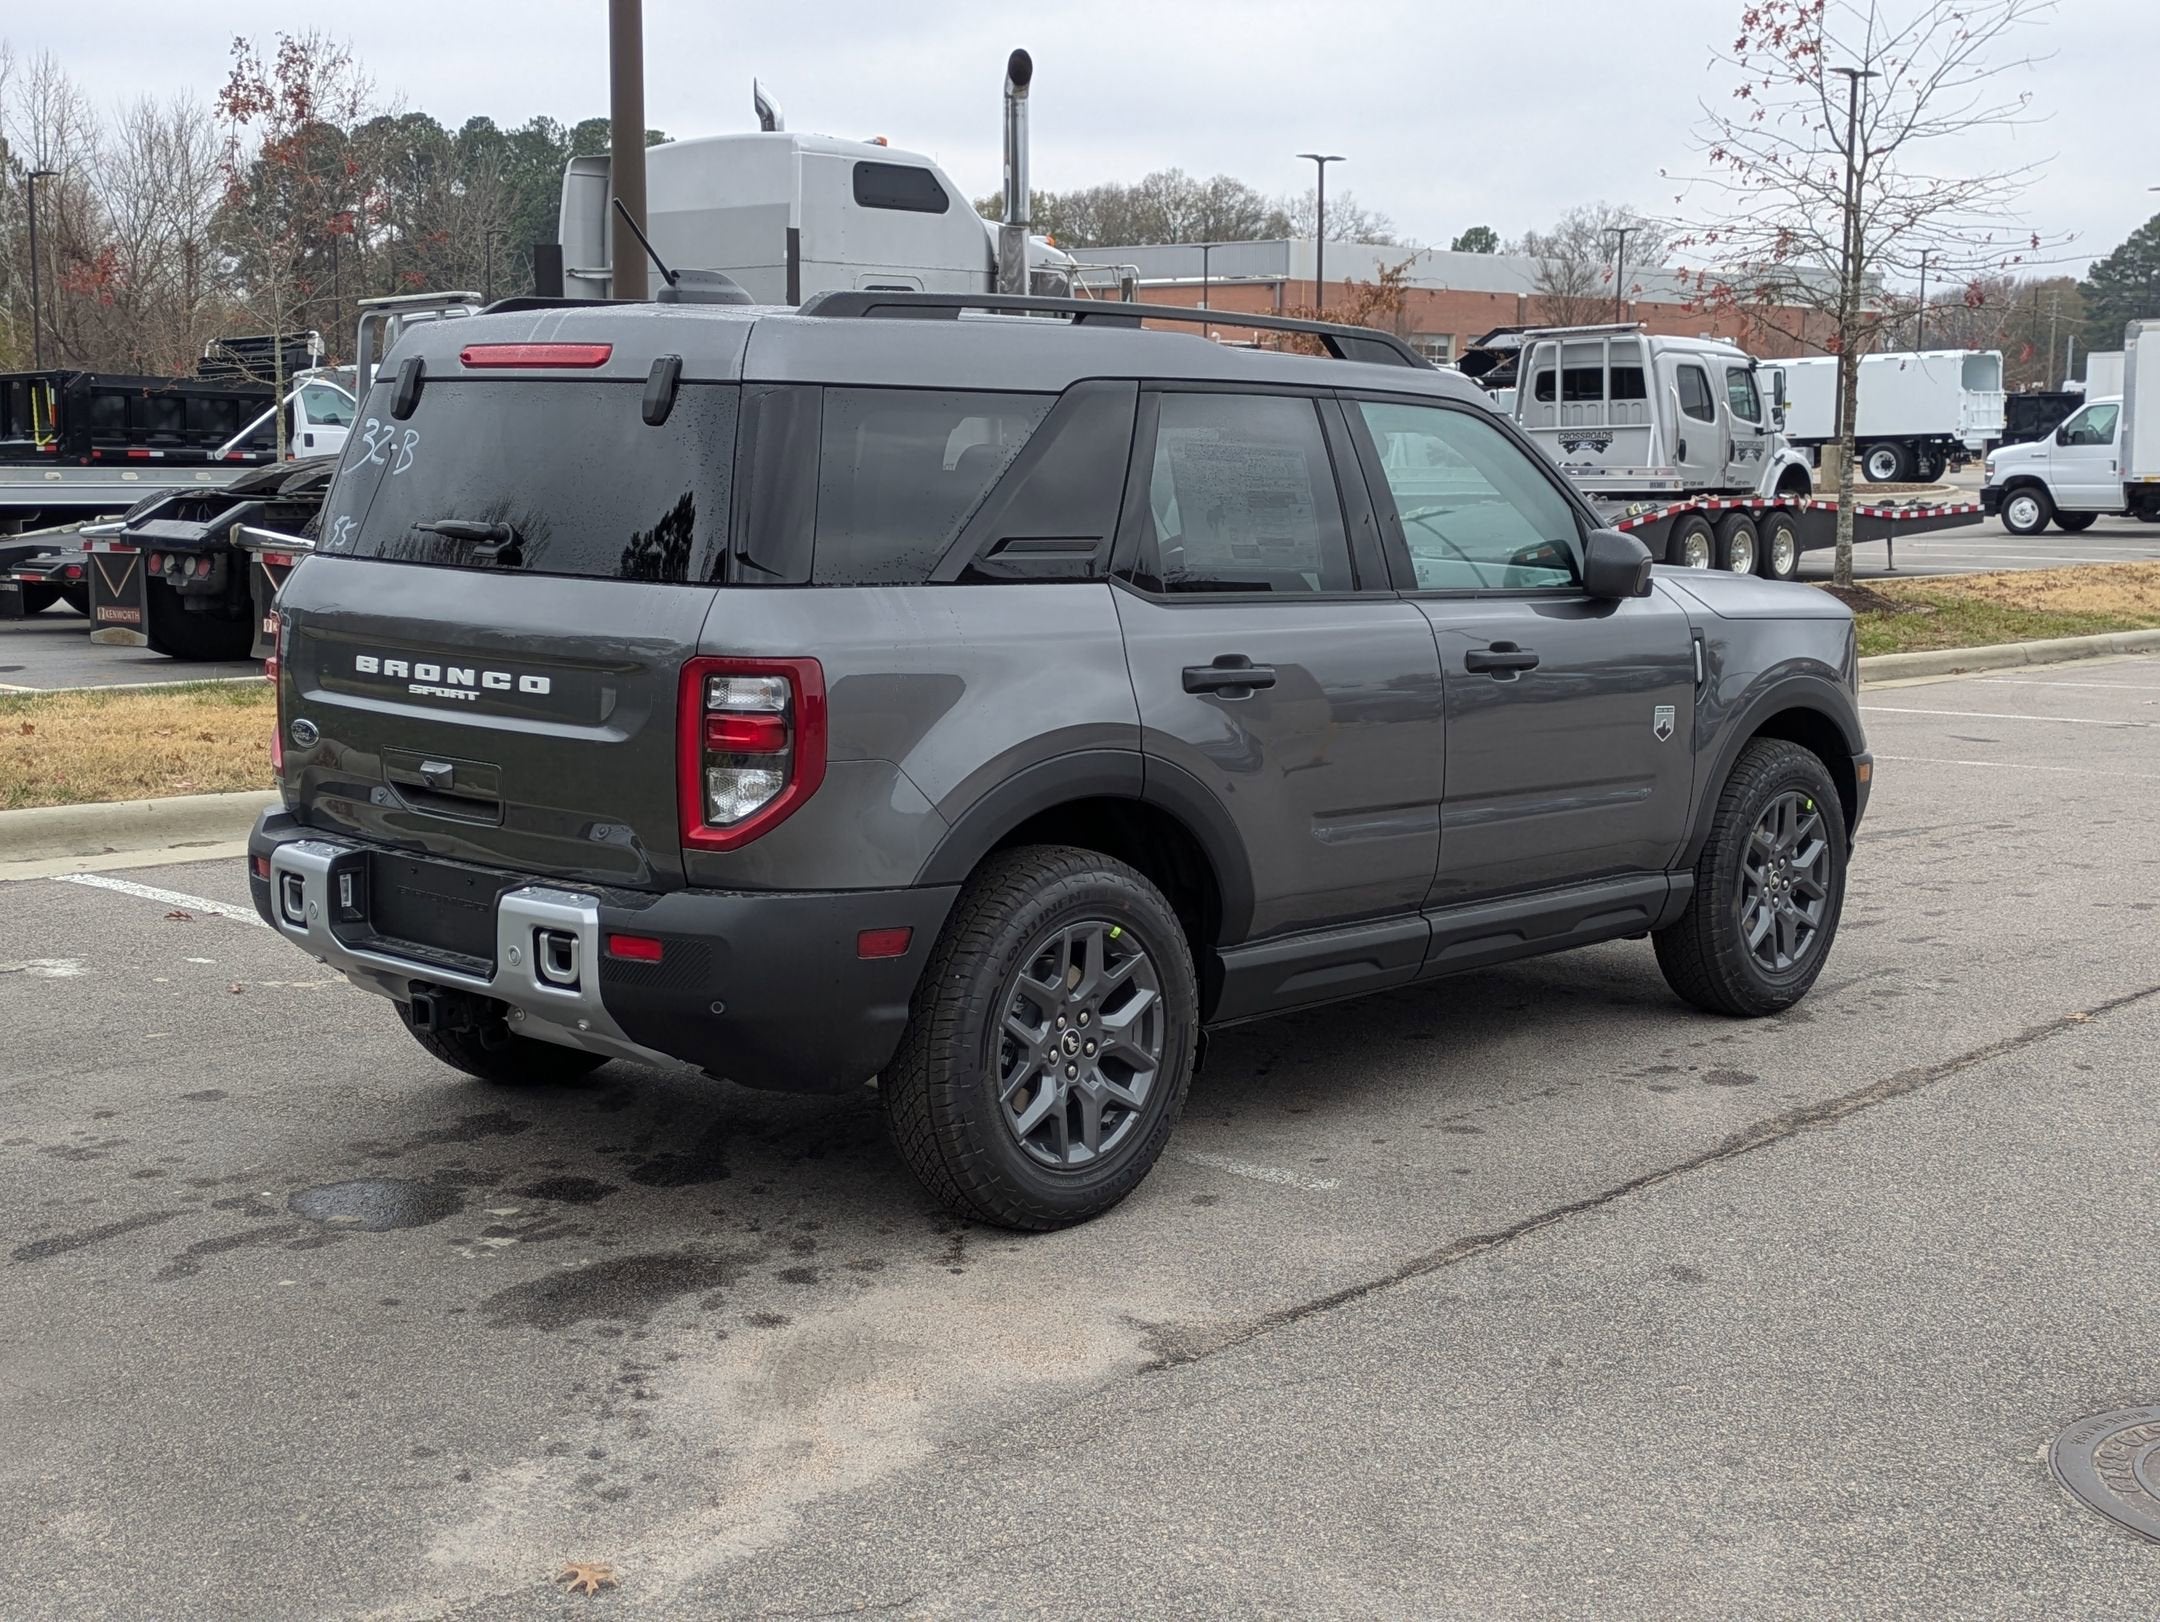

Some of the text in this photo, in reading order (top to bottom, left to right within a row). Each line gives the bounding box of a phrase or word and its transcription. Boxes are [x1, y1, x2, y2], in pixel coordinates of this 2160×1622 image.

[1558, 431, 1613, 442] CROSSROADS
[105, 609, 140, 622] KENWORTH
[355, 655, 550, 694] BRONCO
[408, 684, 480, 701] SPORT
